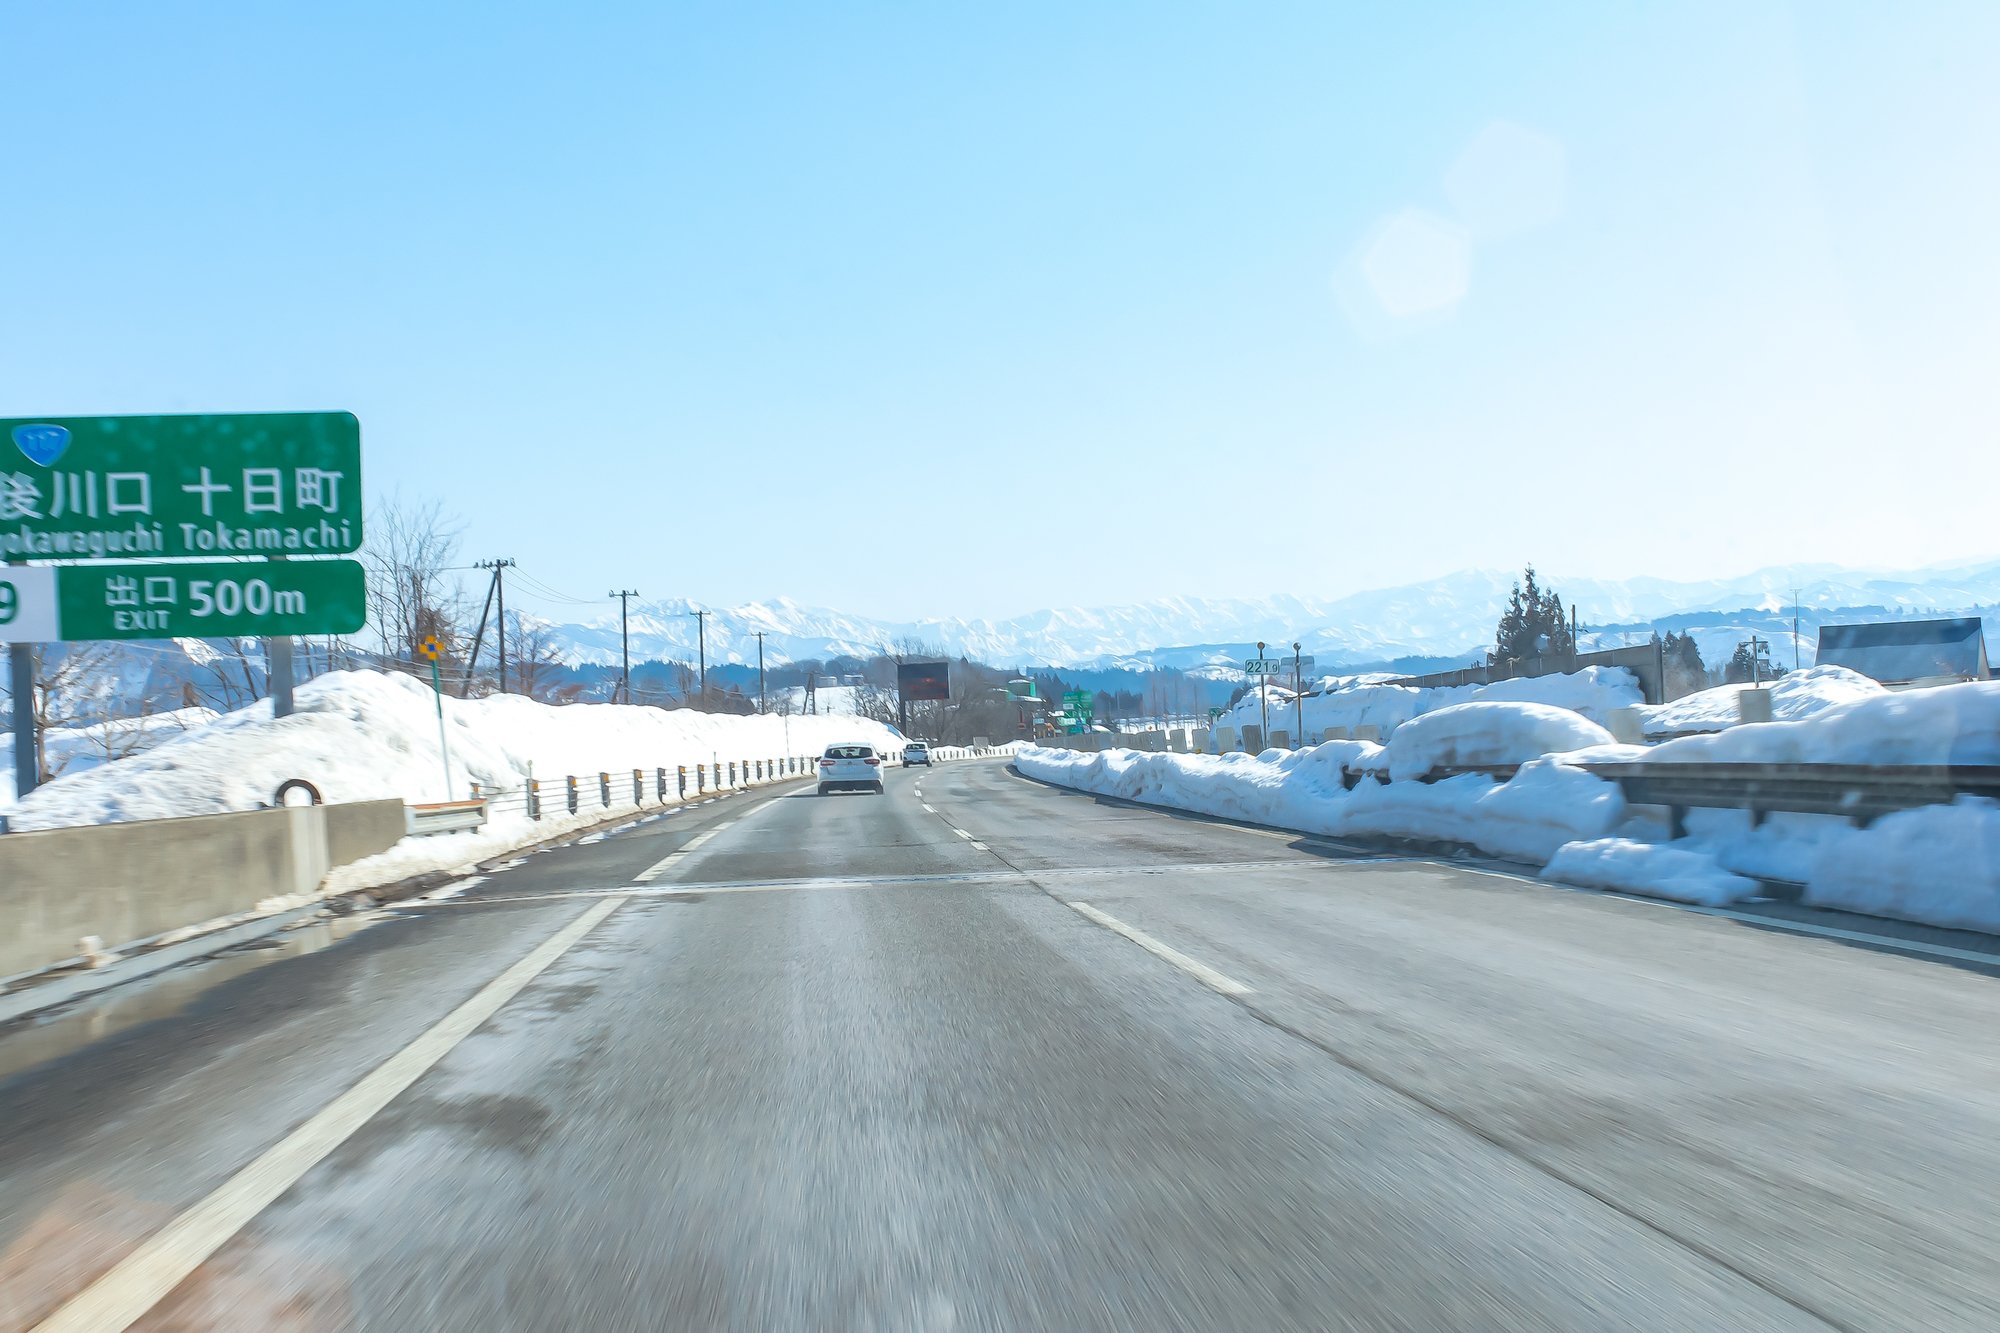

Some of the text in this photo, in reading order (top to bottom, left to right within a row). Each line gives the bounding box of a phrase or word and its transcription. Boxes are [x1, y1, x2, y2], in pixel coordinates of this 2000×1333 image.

[181, 466, 344, 516] 十日町
[178, 519, 350, 551] Tokamachi
[105, 575, 177, 606] 出口
[188, 578, 306, 617] 500m
[113, 610, 171, 630] EXIT
